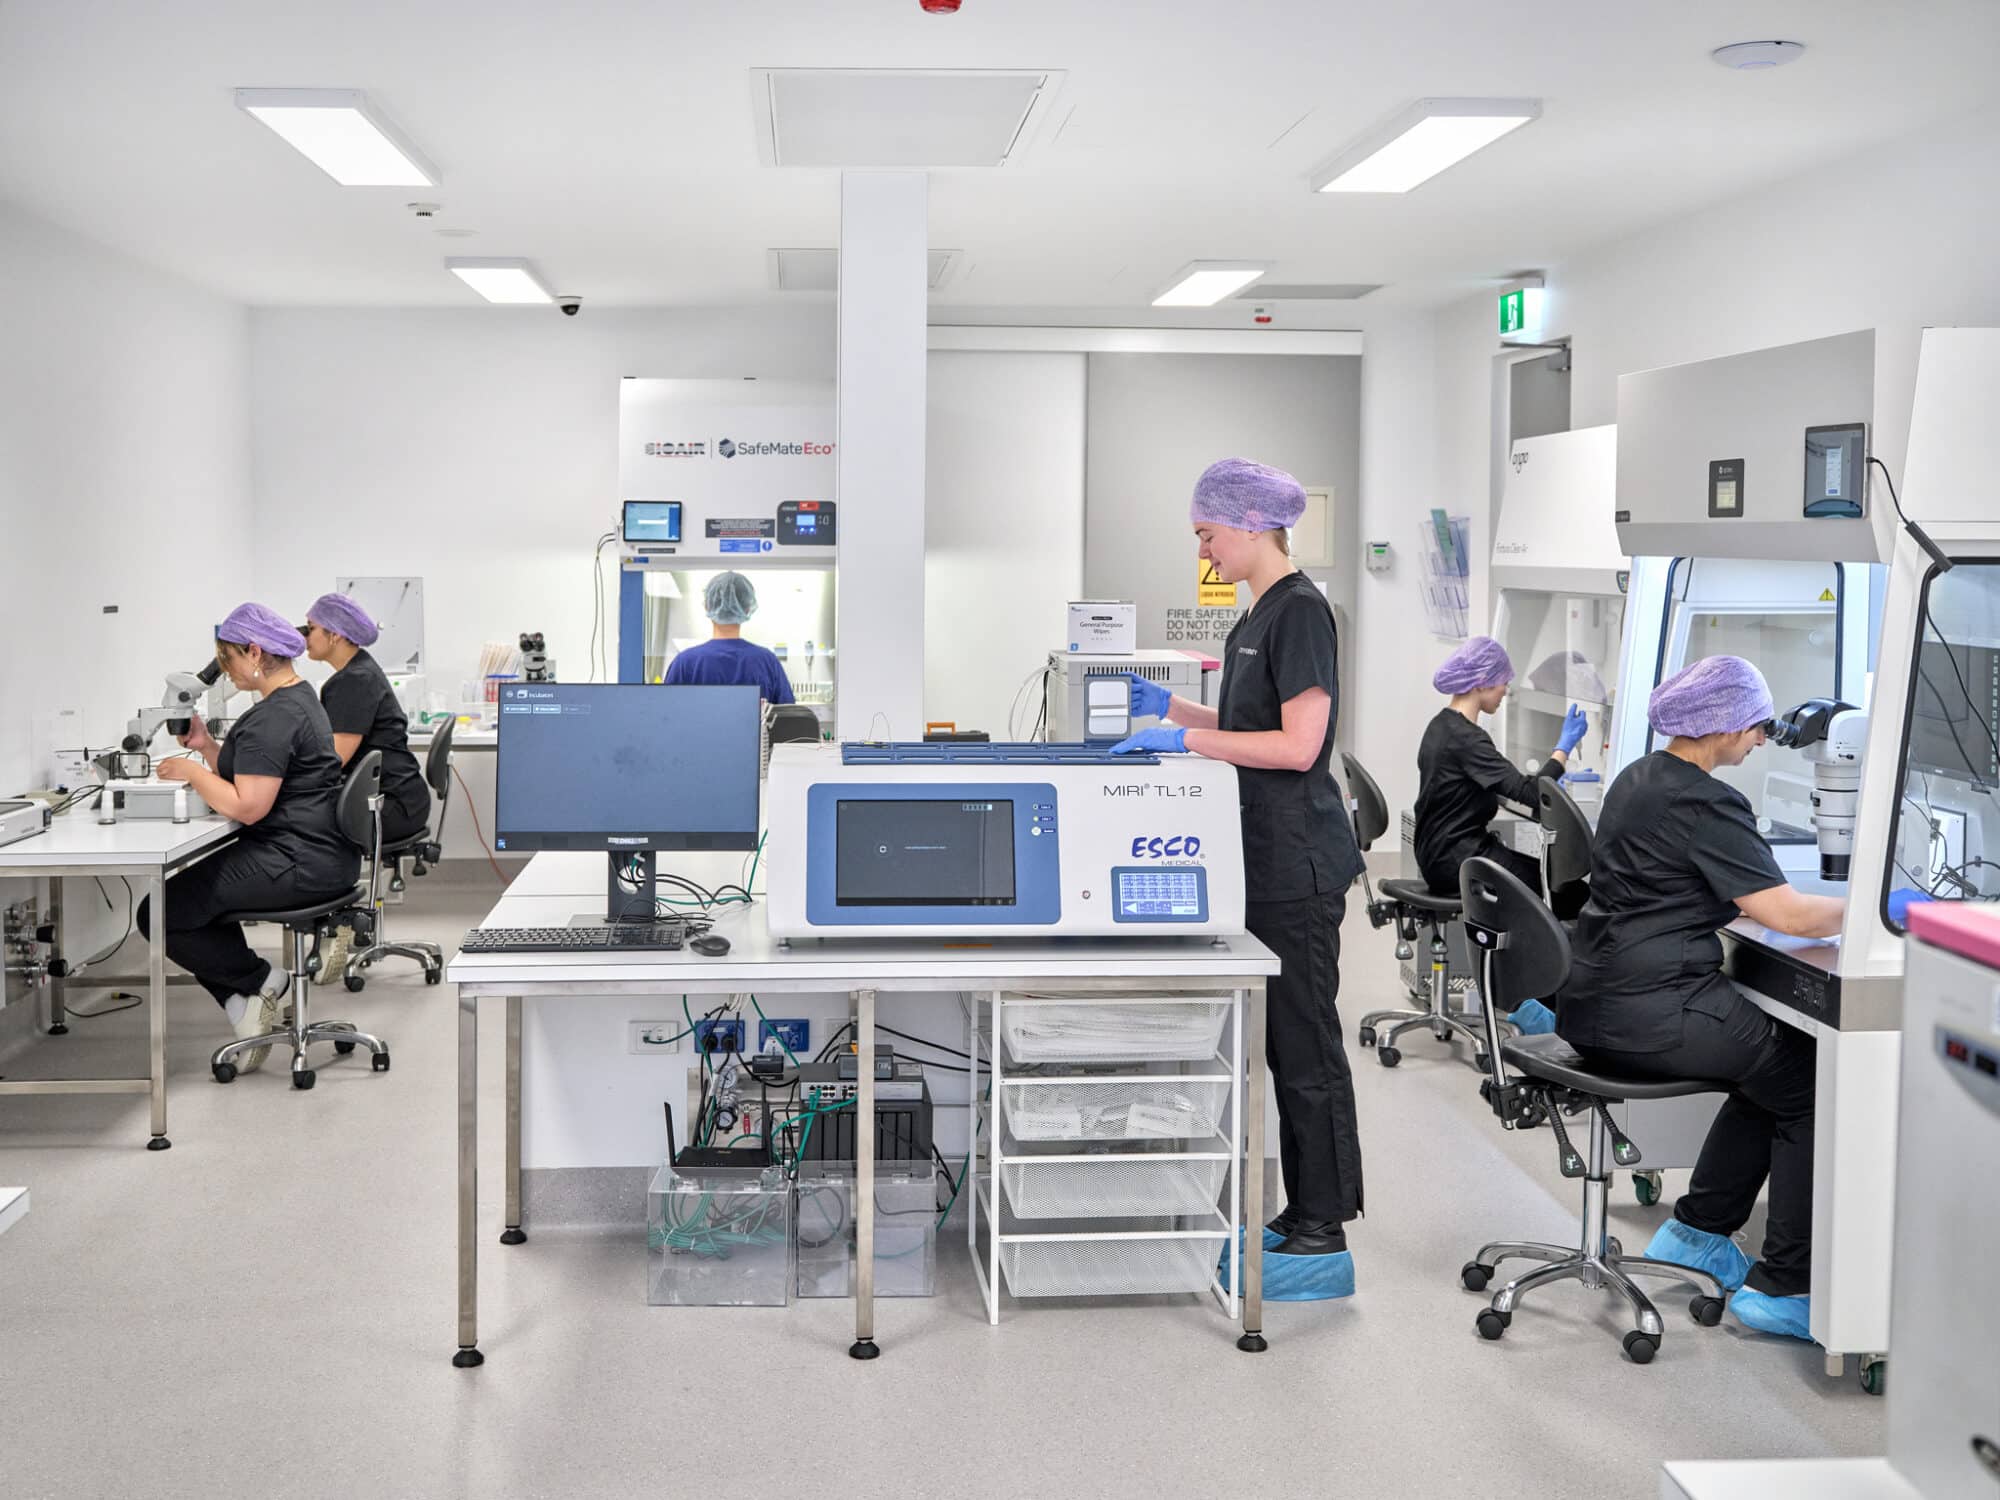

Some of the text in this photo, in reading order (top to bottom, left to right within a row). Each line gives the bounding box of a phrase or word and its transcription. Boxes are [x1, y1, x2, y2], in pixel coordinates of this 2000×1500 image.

[1167, 609, 1192, 619] FIRE
[1195, 609, 1238, 619] SAFETY
[1167, 620, 1184, 630] DO
[1186, 620, 1210, 630] NOT
[1166, 631, 1184, 641] DO
[1186, 631, 1210, 641] NOT
[1154, 784, 1203, 797] TL12
